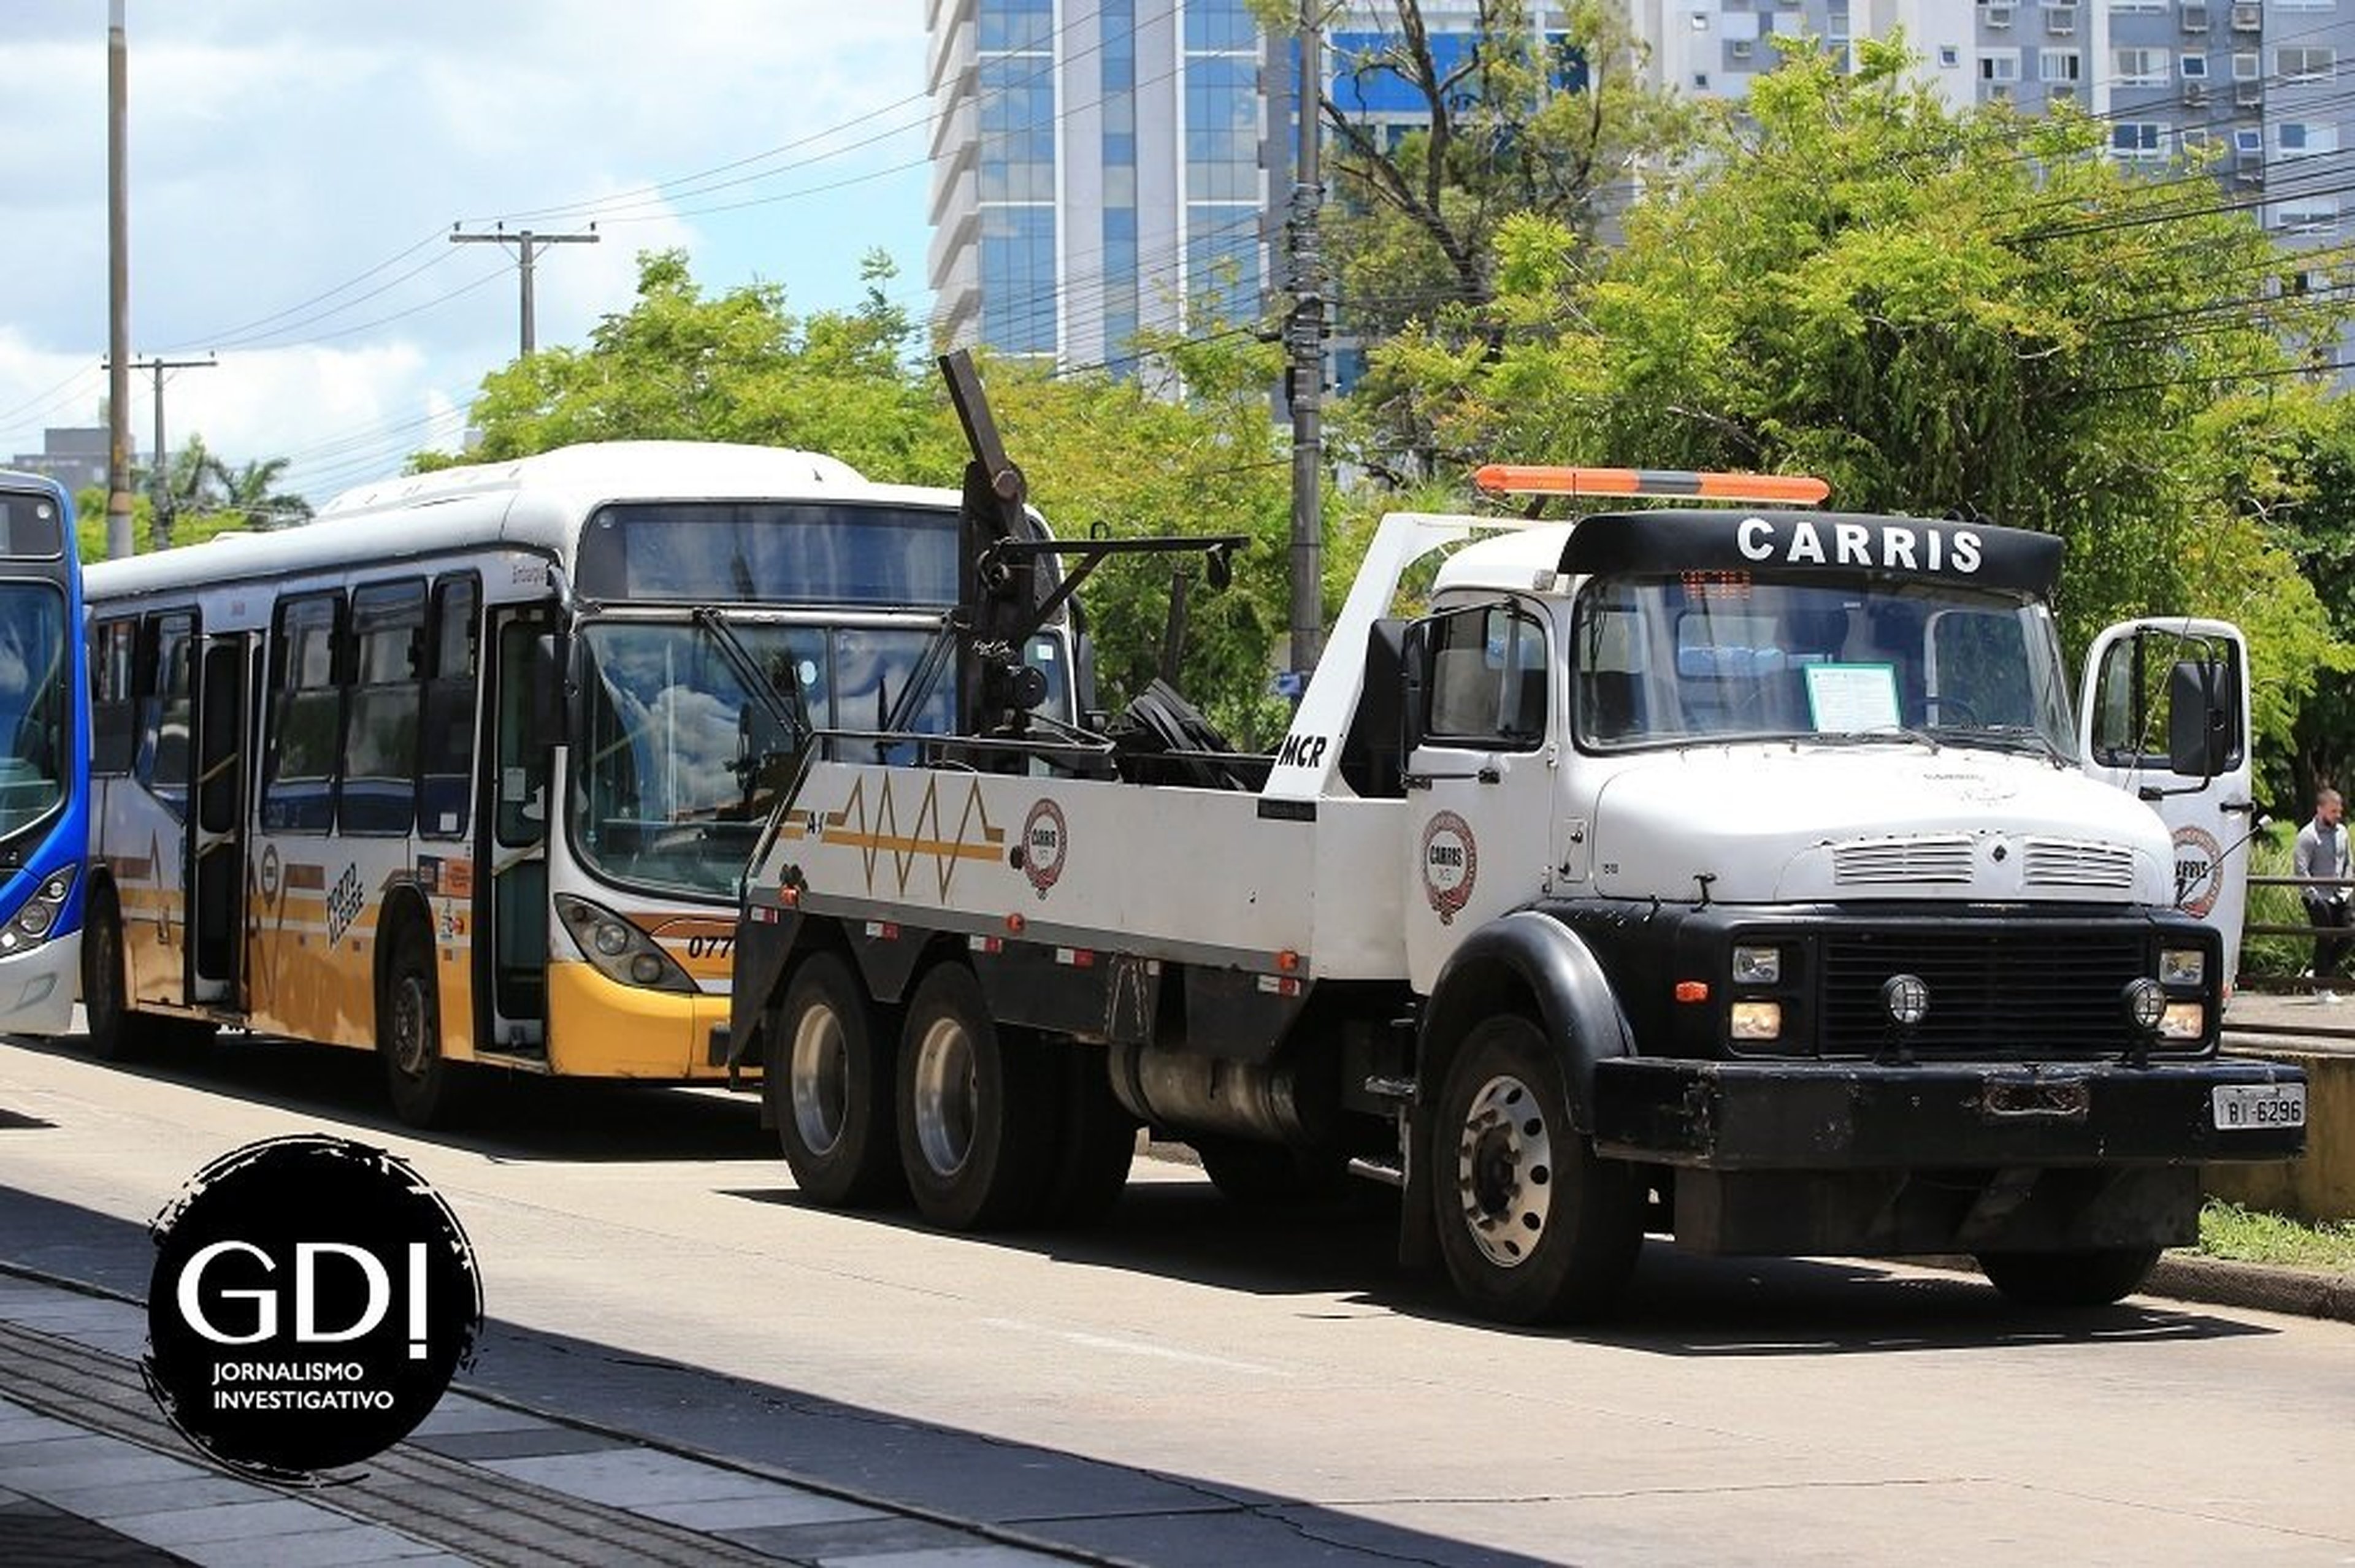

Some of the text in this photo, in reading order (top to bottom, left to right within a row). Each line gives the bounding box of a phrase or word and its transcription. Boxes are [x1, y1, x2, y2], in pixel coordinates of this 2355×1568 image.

[1737, 518, 1982, 573] CARRIS
[1277, 734, 1327, 768] MCR
[1430, 844, 1463, 868] CARRIS
[2176, 860, 2208, 879] ARRIS
[327, 861, 356, 922] PORTO
[328, 881, 364, 949] ALEGRE
[689, 936, 735, 958] 077
